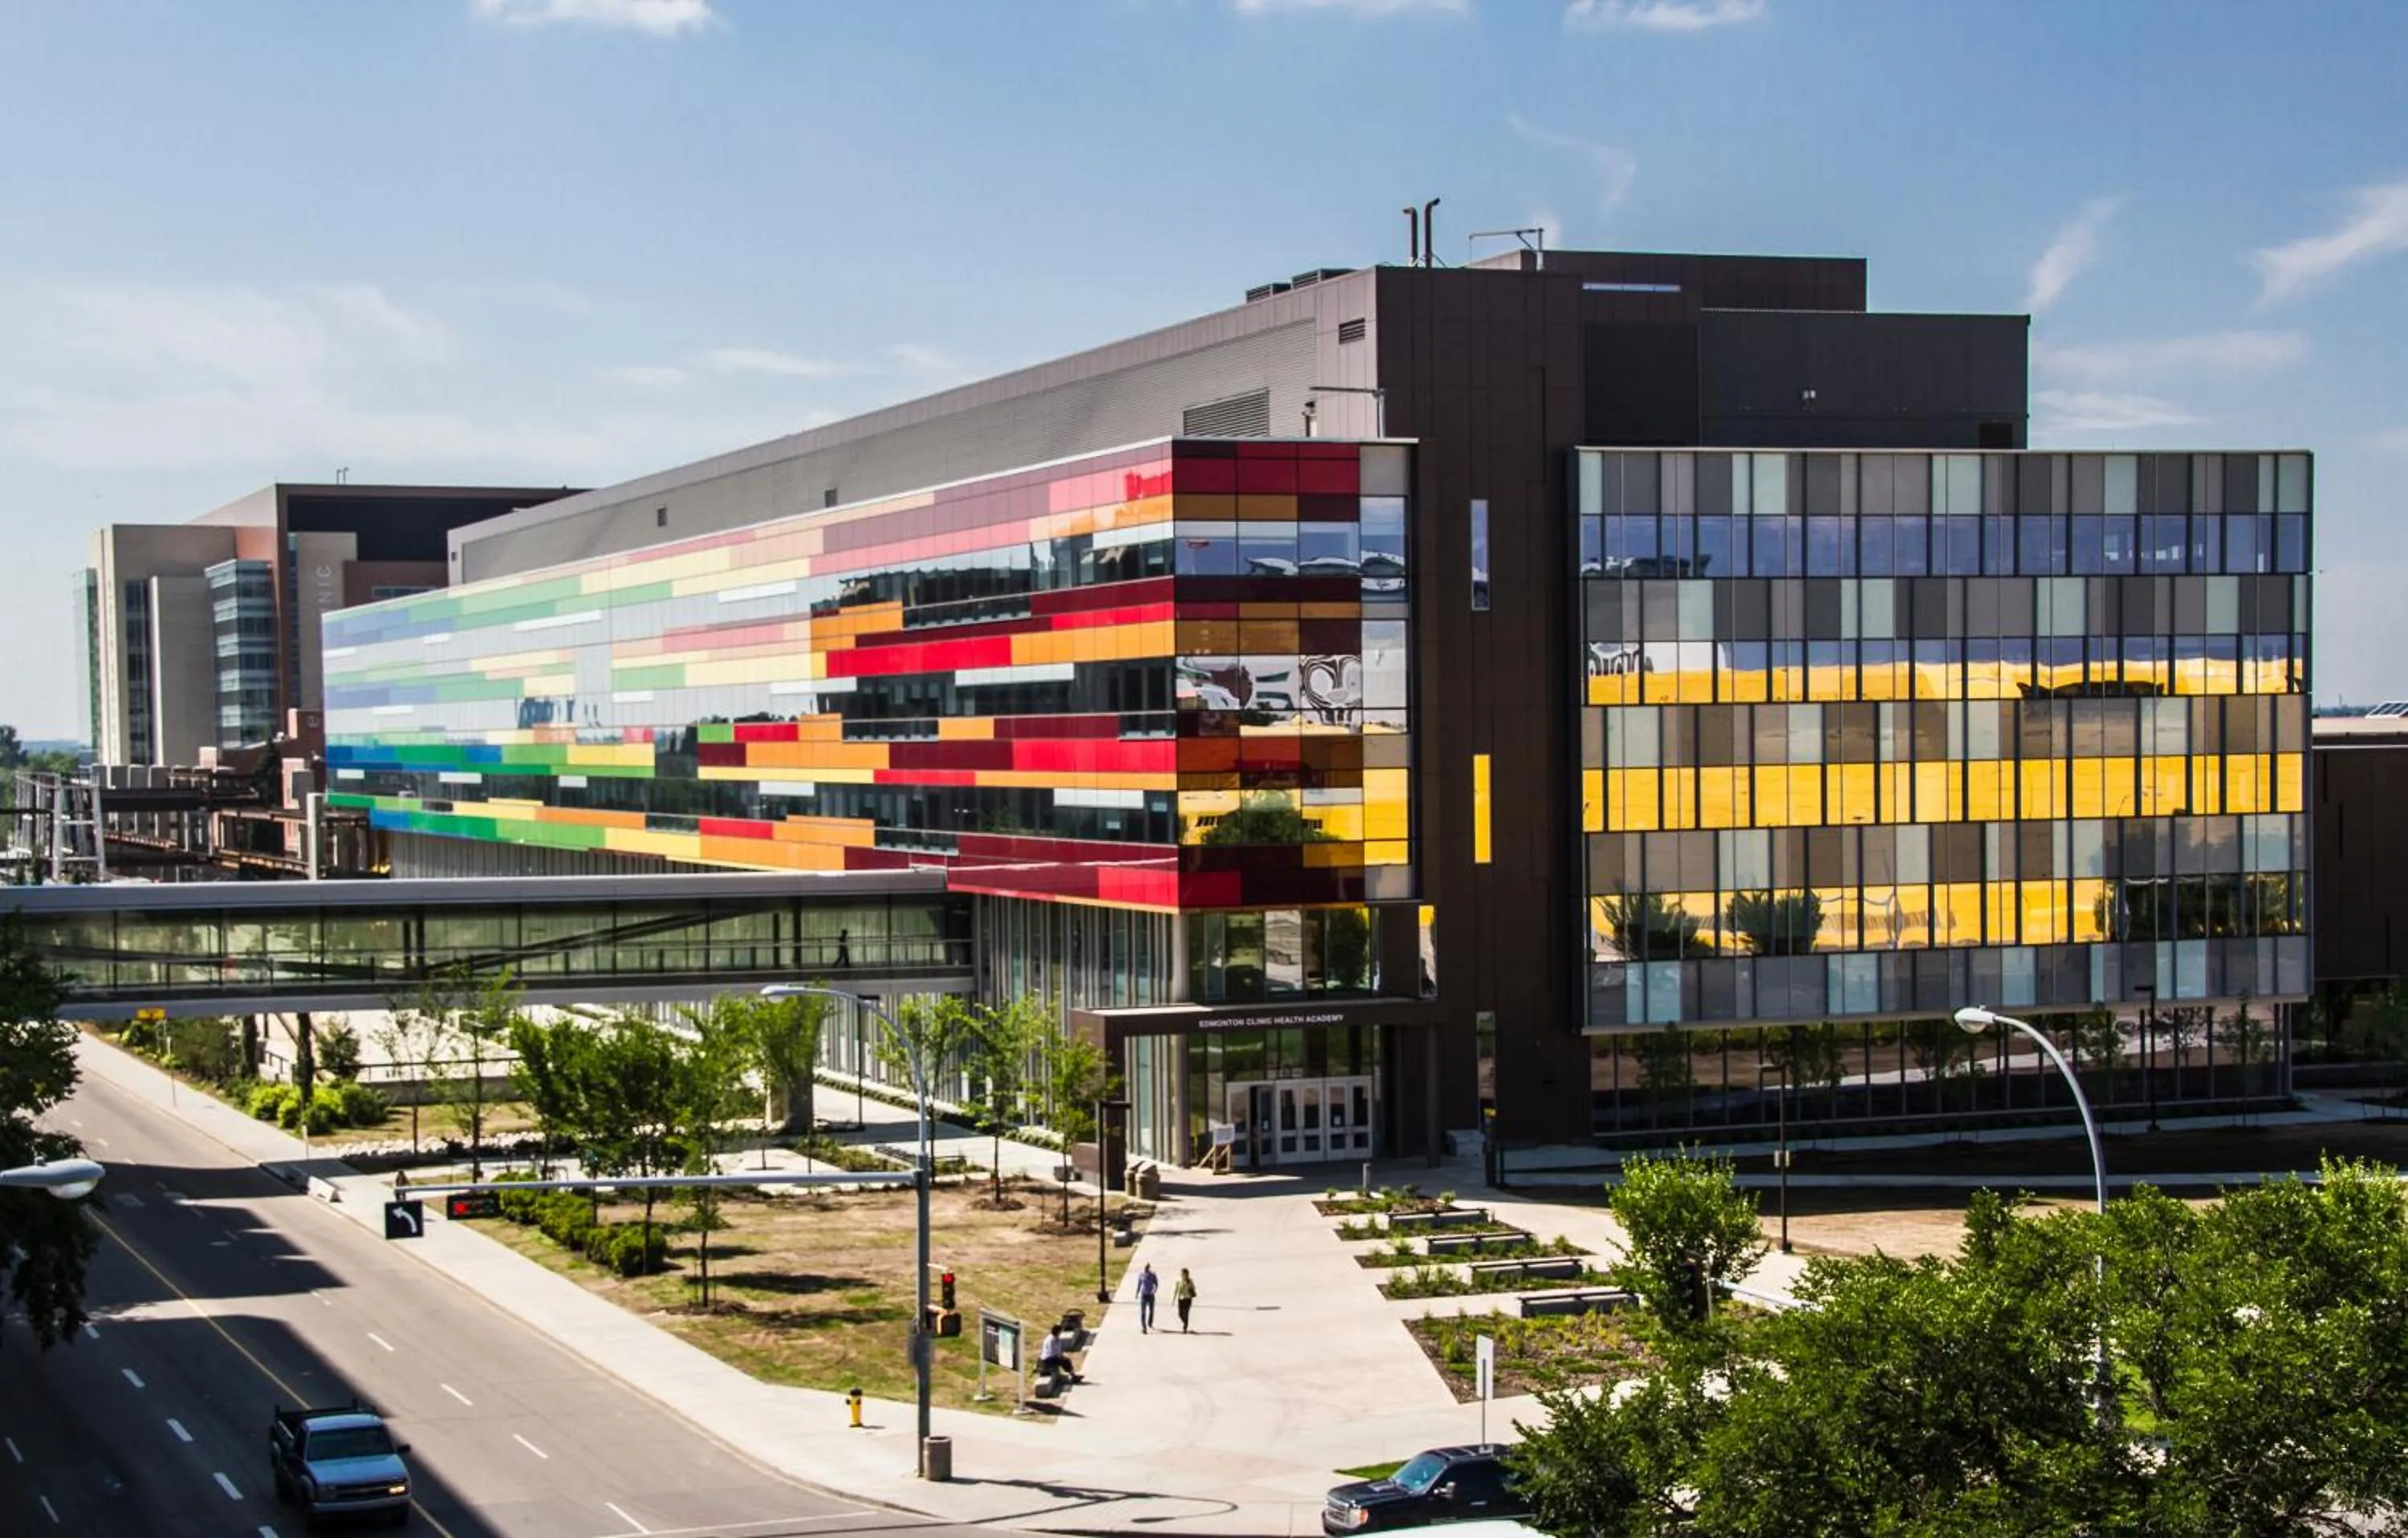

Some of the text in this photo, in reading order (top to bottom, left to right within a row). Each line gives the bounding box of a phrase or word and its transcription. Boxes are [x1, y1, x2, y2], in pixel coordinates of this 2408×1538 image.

[1198, 1014, 1344, 1027] EDMONTON CLINIC HEALTH ACADEMY
